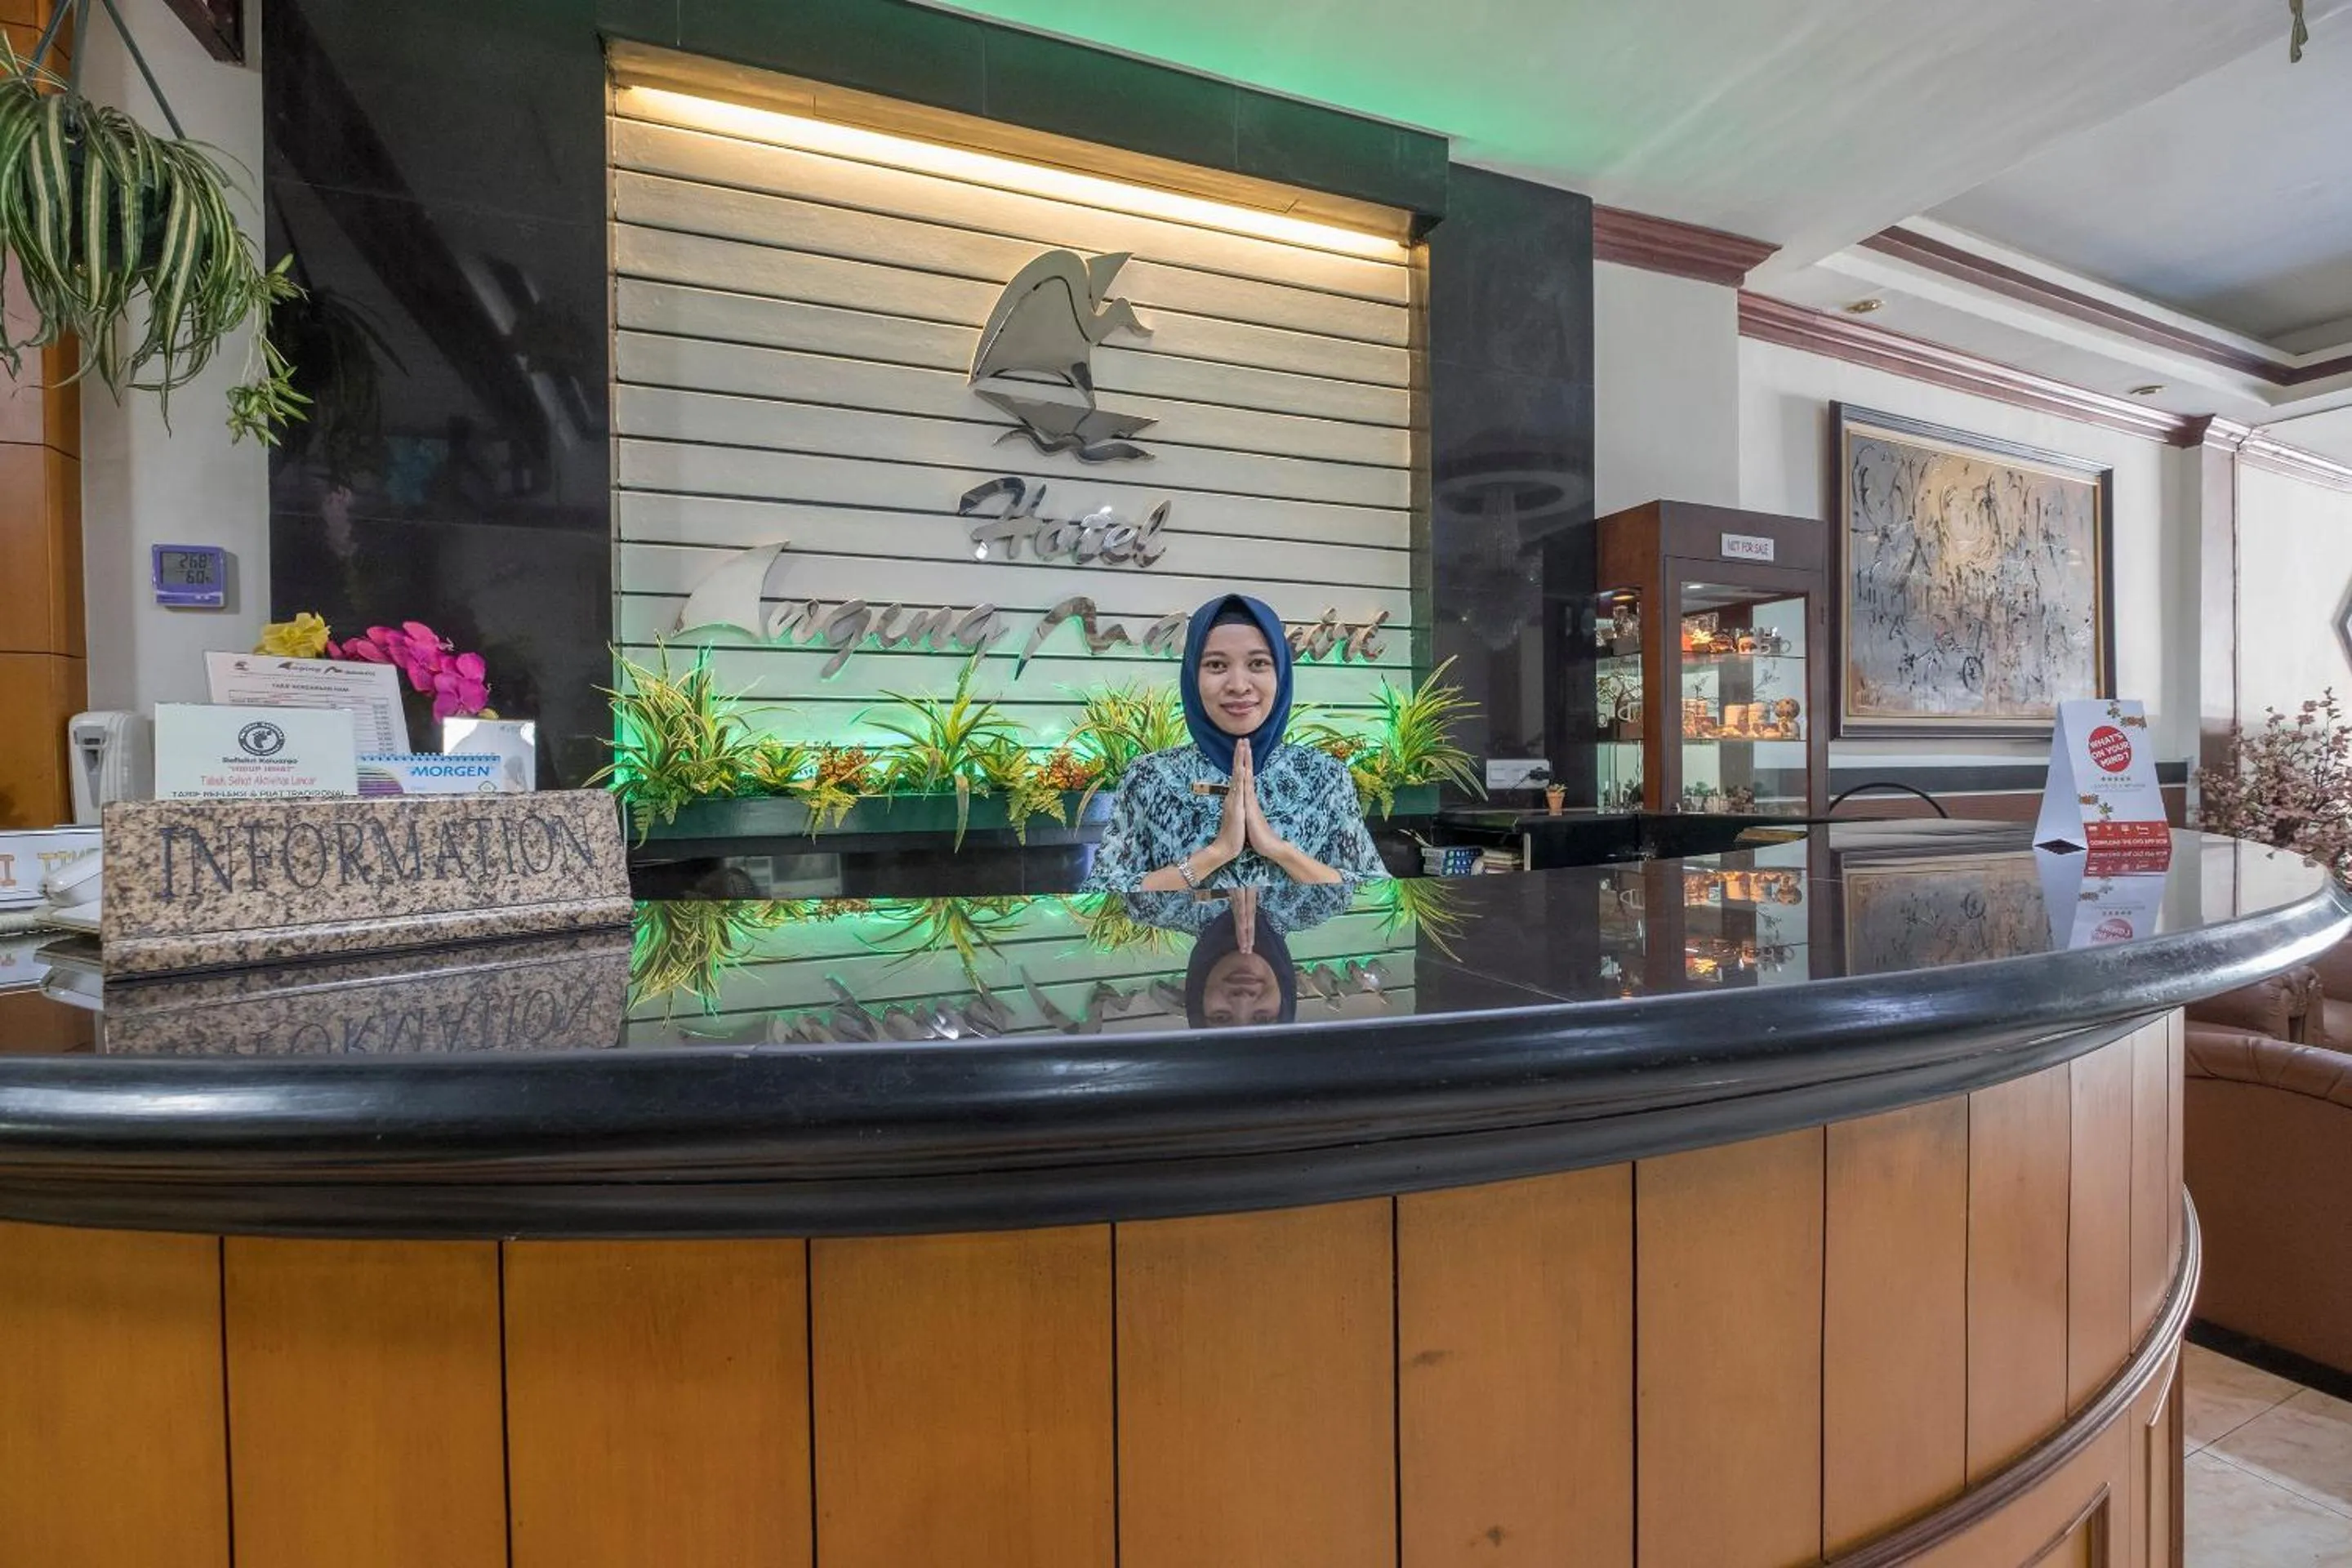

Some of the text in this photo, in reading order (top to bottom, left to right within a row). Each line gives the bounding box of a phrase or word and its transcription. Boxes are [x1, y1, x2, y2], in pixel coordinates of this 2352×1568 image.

[958, 476, 1172, 568] Hotel
[1741, 541, 1754, 554] FOR
[2090, 733, 2124, 749] WHAT'S
[2091, 741, 2129, 760] ON YOUR
[2100, 751, 2129, 767] MIND?
[412, 766, 490, 777] MORGEN
[158, 814, 598, 898] INFORMATION
